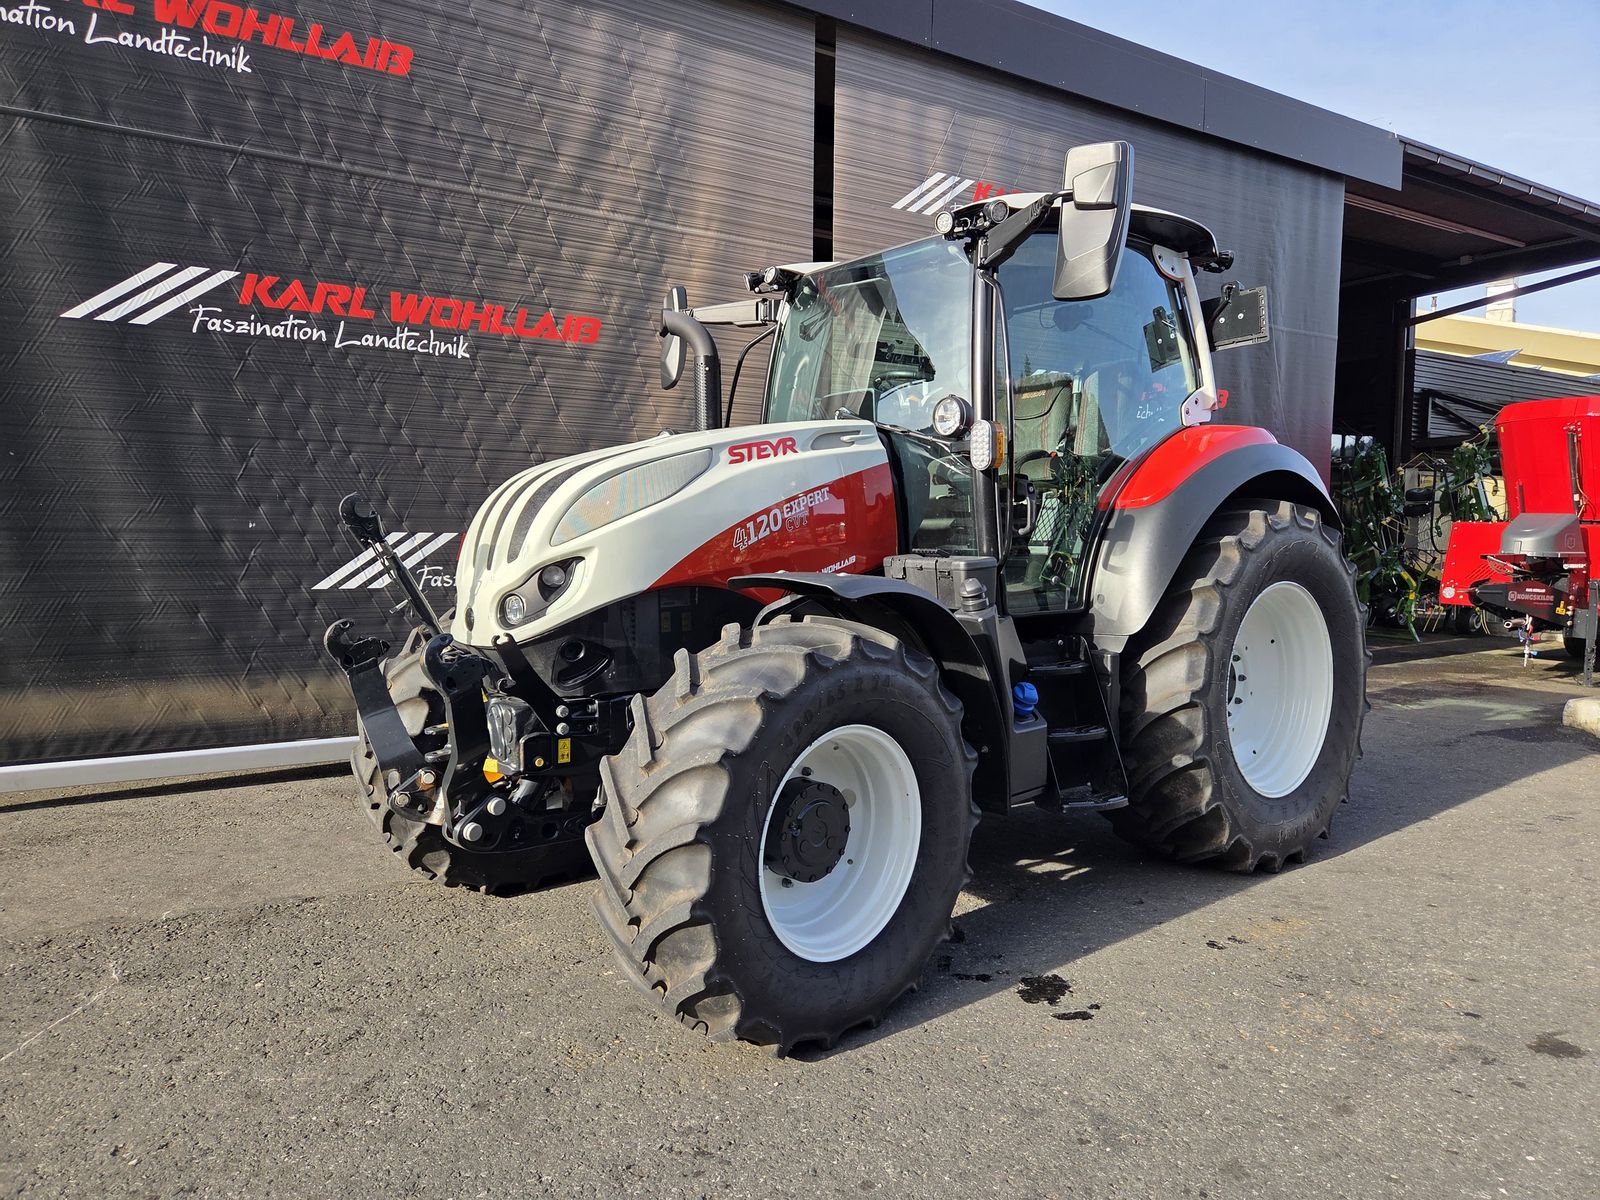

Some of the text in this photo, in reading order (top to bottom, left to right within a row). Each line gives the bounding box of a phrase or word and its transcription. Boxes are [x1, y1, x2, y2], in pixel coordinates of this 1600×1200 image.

[84, 11, 252, 73] Landtechnik
[153, 0, 414, 77] WOHLLAIB
[189, 304, 471, 360] Faszination Landtechnik
[239, 272, 604, 345] KARL WOHLLAIB
[728, 437, 799, 465] STEYR
[732, 486, 830, 550] 4120 EXPERT
[785, 510, 809, 532] CVT
